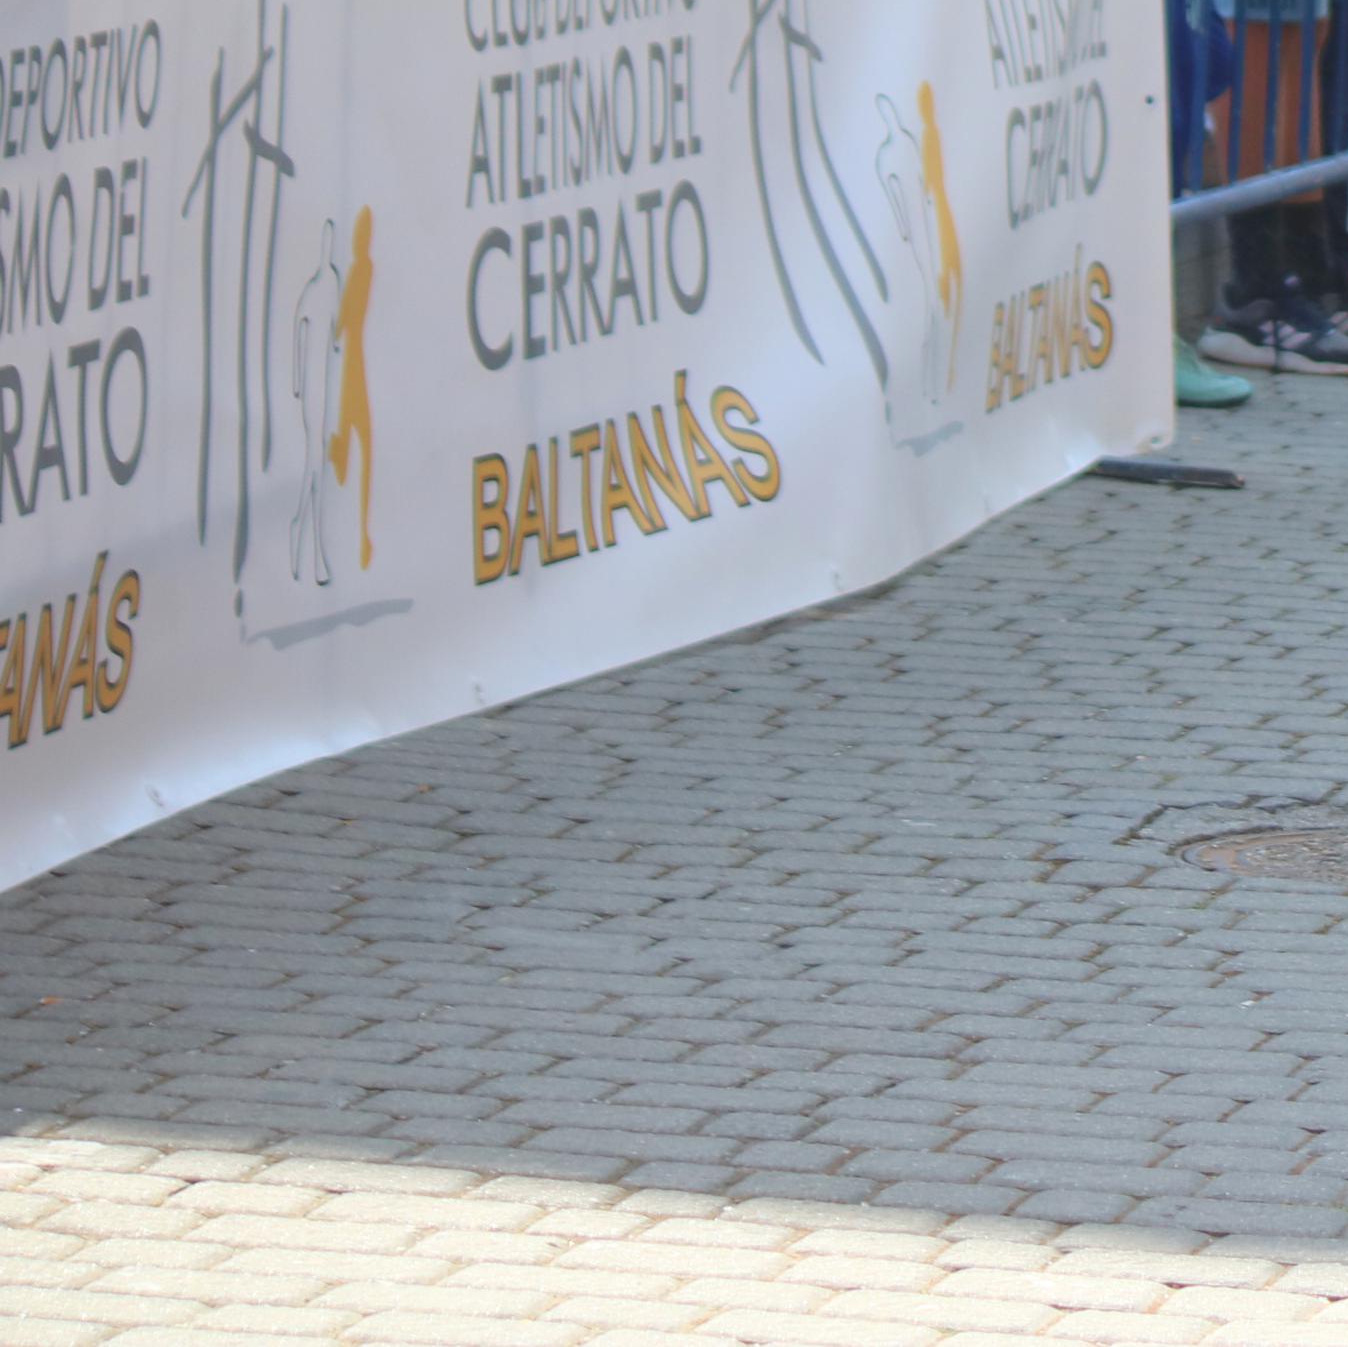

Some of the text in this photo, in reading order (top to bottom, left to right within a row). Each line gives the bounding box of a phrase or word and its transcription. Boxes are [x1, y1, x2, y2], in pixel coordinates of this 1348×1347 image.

[0, 18, 162, 160] EPORTIVO
[465, 34, 702, 209] ATLETISMO DEL
[88, 155, 149, 312] DEL
[467, 179, 710, 372] CERRATO
[473, 369, 781, 586] BALTANÁS
